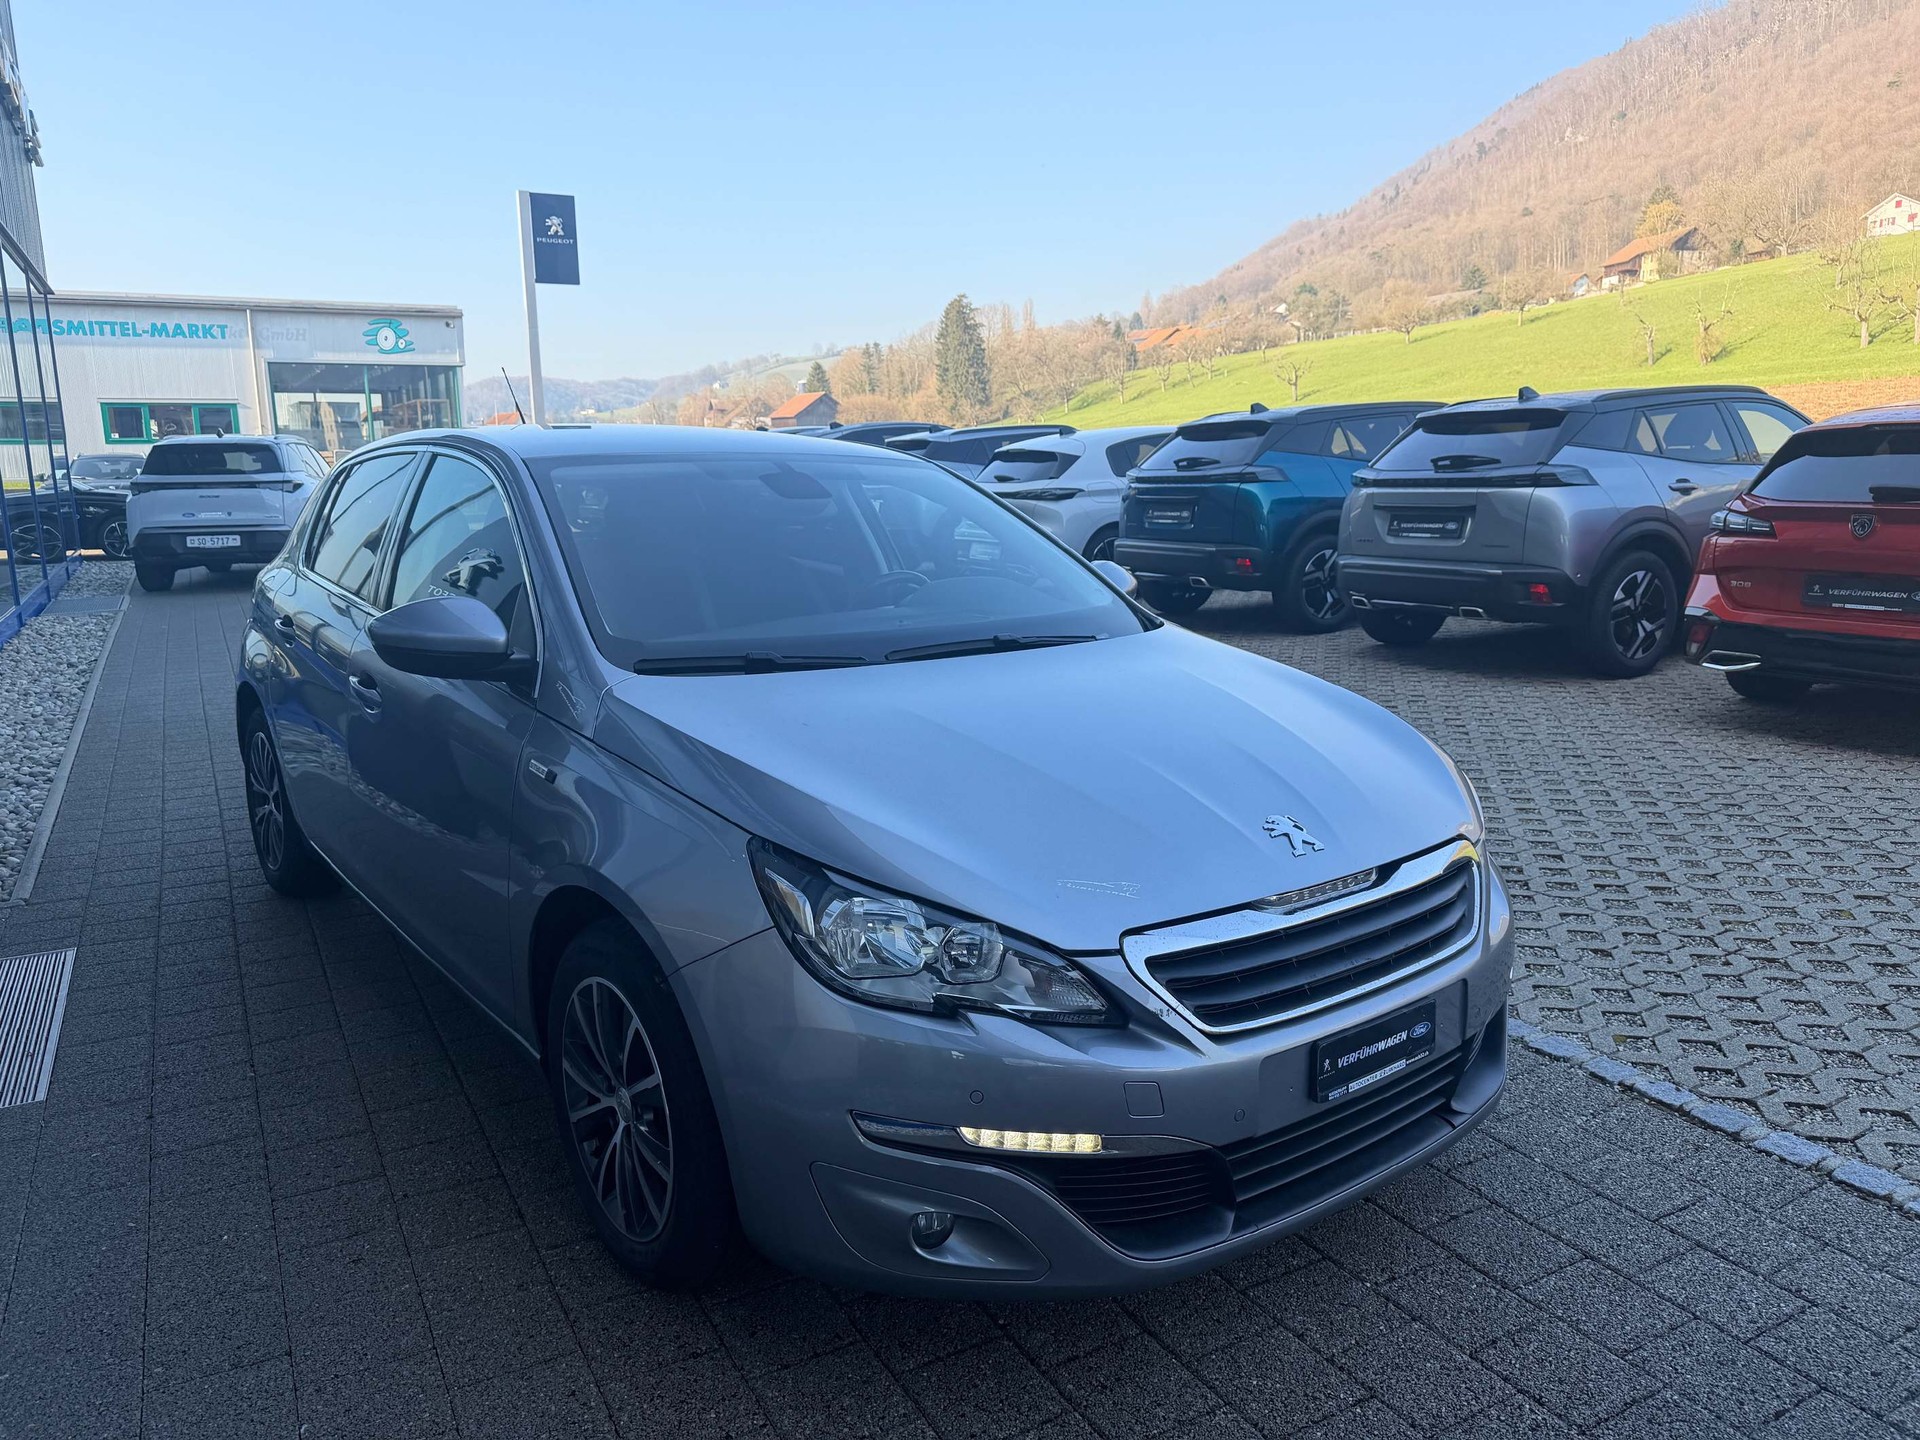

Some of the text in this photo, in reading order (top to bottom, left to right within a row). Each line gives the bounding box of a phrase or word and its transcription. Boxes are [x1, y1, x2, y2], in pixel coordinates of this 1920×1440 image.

[1730, 580, 1751, 588] 308
[1828, 588, 1908, 599] VERFÜHRWAGEN
[1337, 1030, 1408, 1068] VERFÜHRWAGEN
